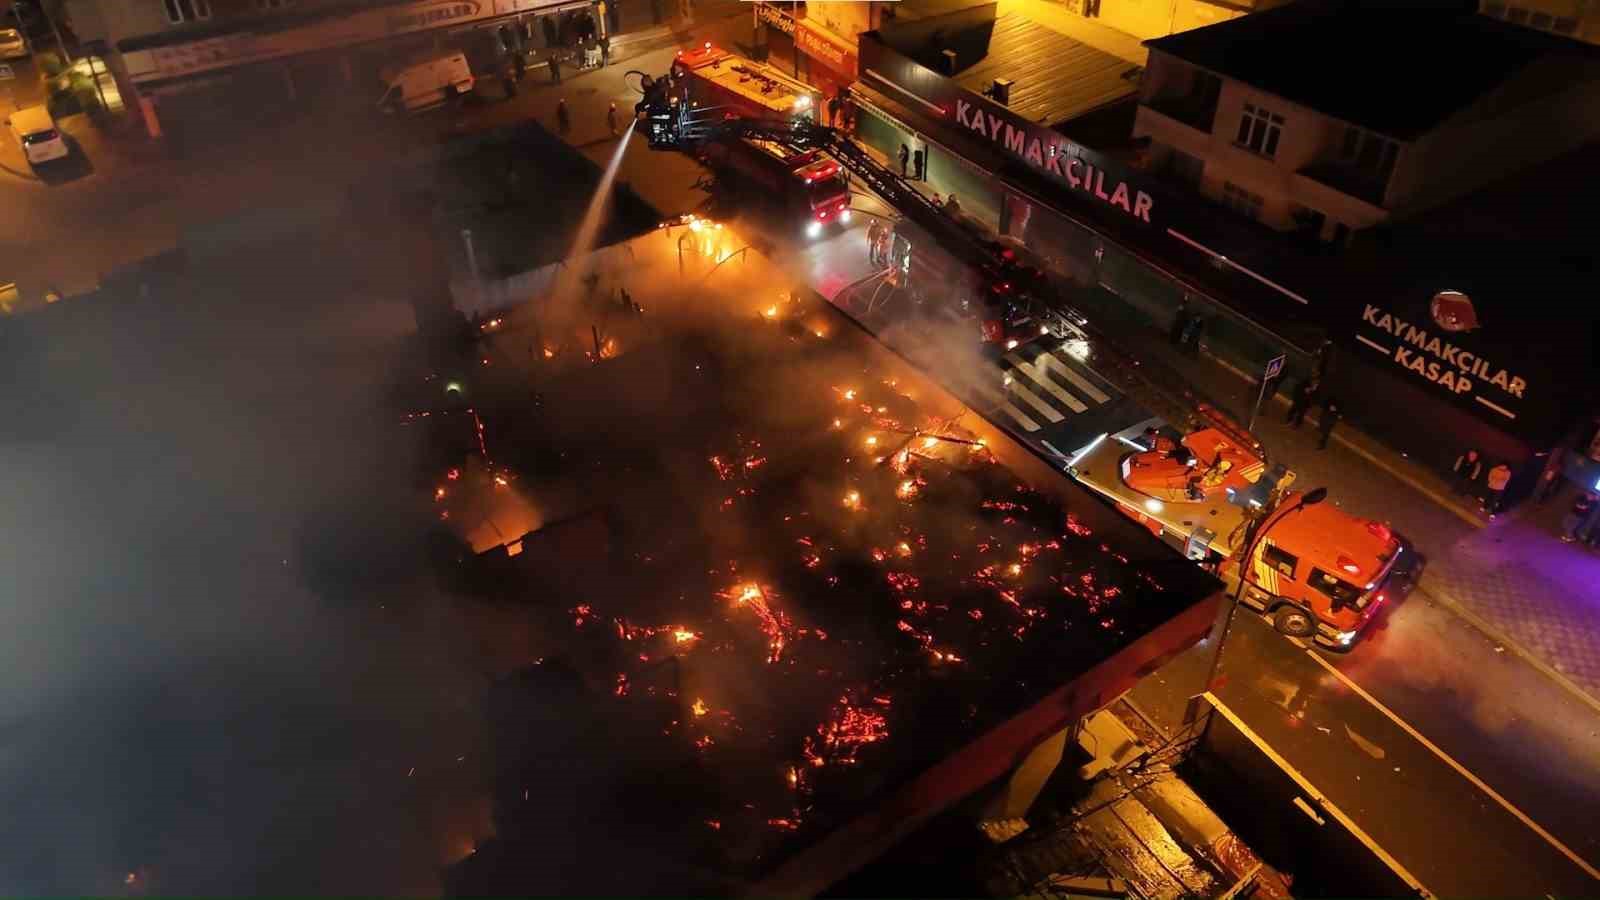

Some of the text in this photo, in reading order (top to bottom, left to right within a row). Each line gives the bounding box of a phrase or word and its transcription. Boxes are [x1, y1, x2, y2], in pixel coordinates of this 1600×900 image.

[956, 99, 1153, 223] KAYMAKÇILAR
[1362, 303, 1527, 399] KAYMAKÇILAR
[1394, 346, 1473, 394] KASAP
